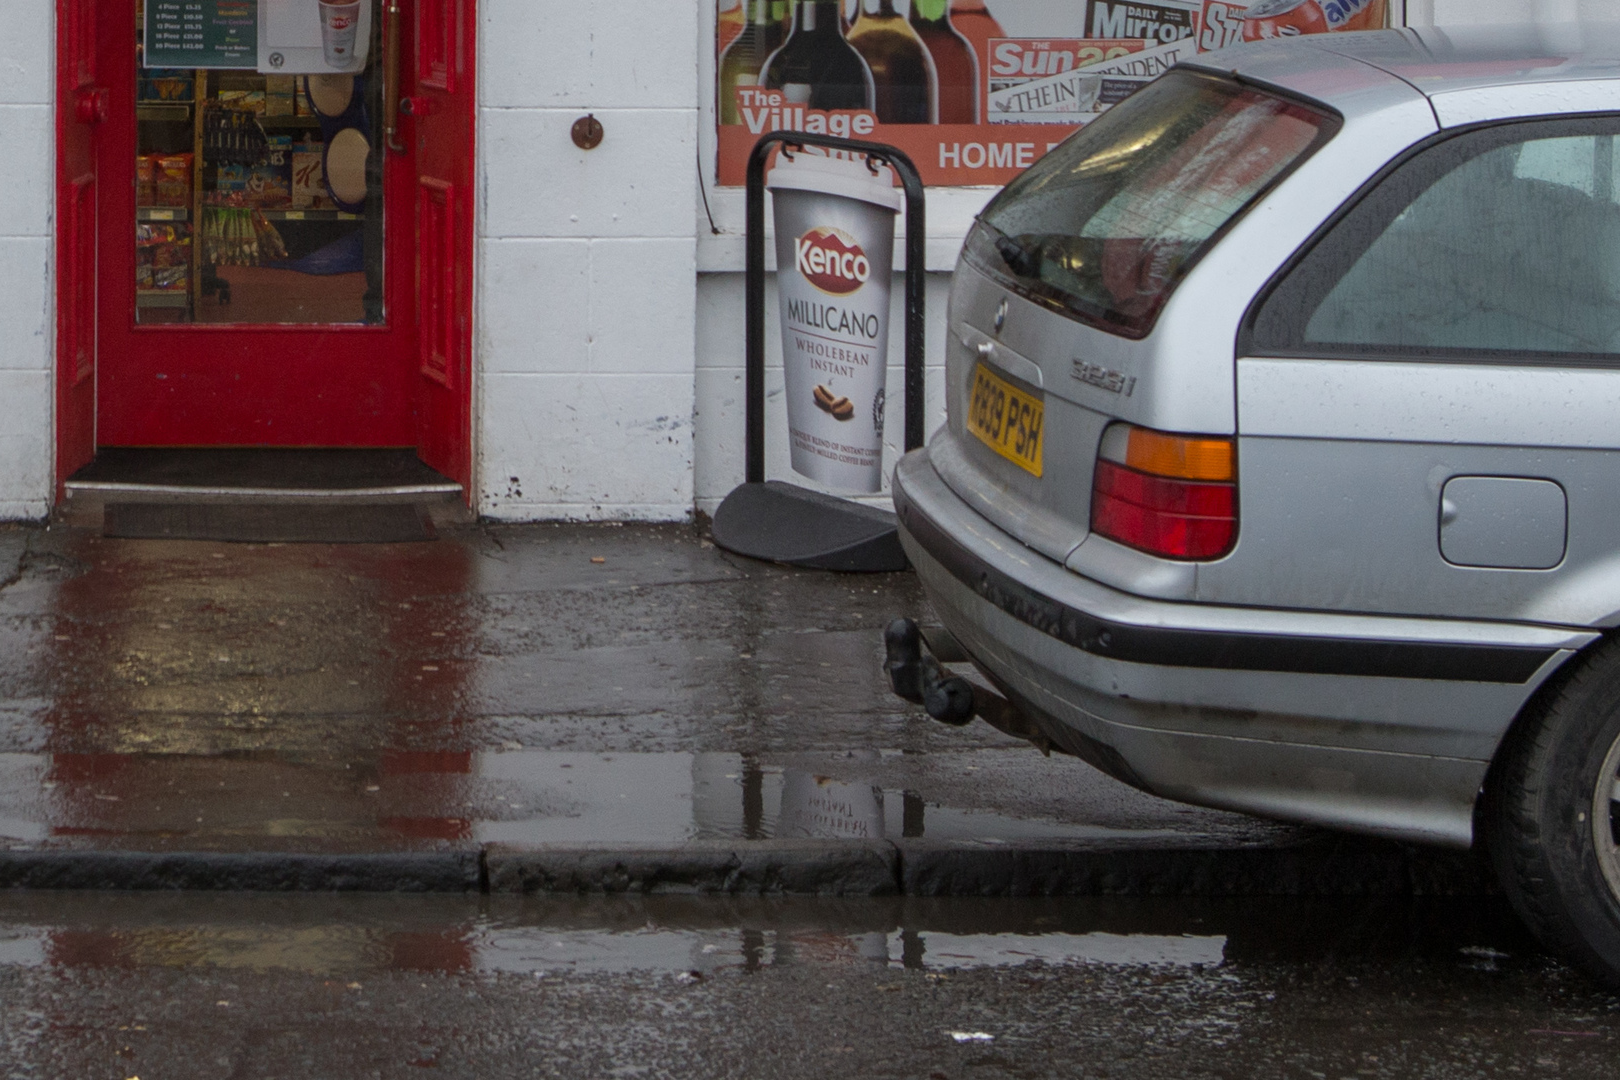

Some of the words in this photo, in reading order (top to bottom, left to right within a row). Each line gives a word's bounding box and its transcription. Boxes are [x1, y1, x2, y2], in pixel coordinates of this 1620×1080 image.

[1093, 0, 1192, 44] Mirror
[1128, 6, 1158, 18] DAILY
[1201, 3, 1245, 51] STA
[992, 42, 1074, 75] Sun
[1032, 42, 1050, 50] THE
[740, 90, 781, 106] The
[1013, 86, 1051, 112] THE
[742, 107, 875, 138] Village
[939, 143, 1034, 169] HOME
[794, 238, 870, 283] Kenco
[788, 298, 879, 339] MILLICANO
[795, 336, 869, 366] WHOLEBEAN
[810, 357, 855, 378] INSTANT
[1003, 396, 1043, 463] PSH
